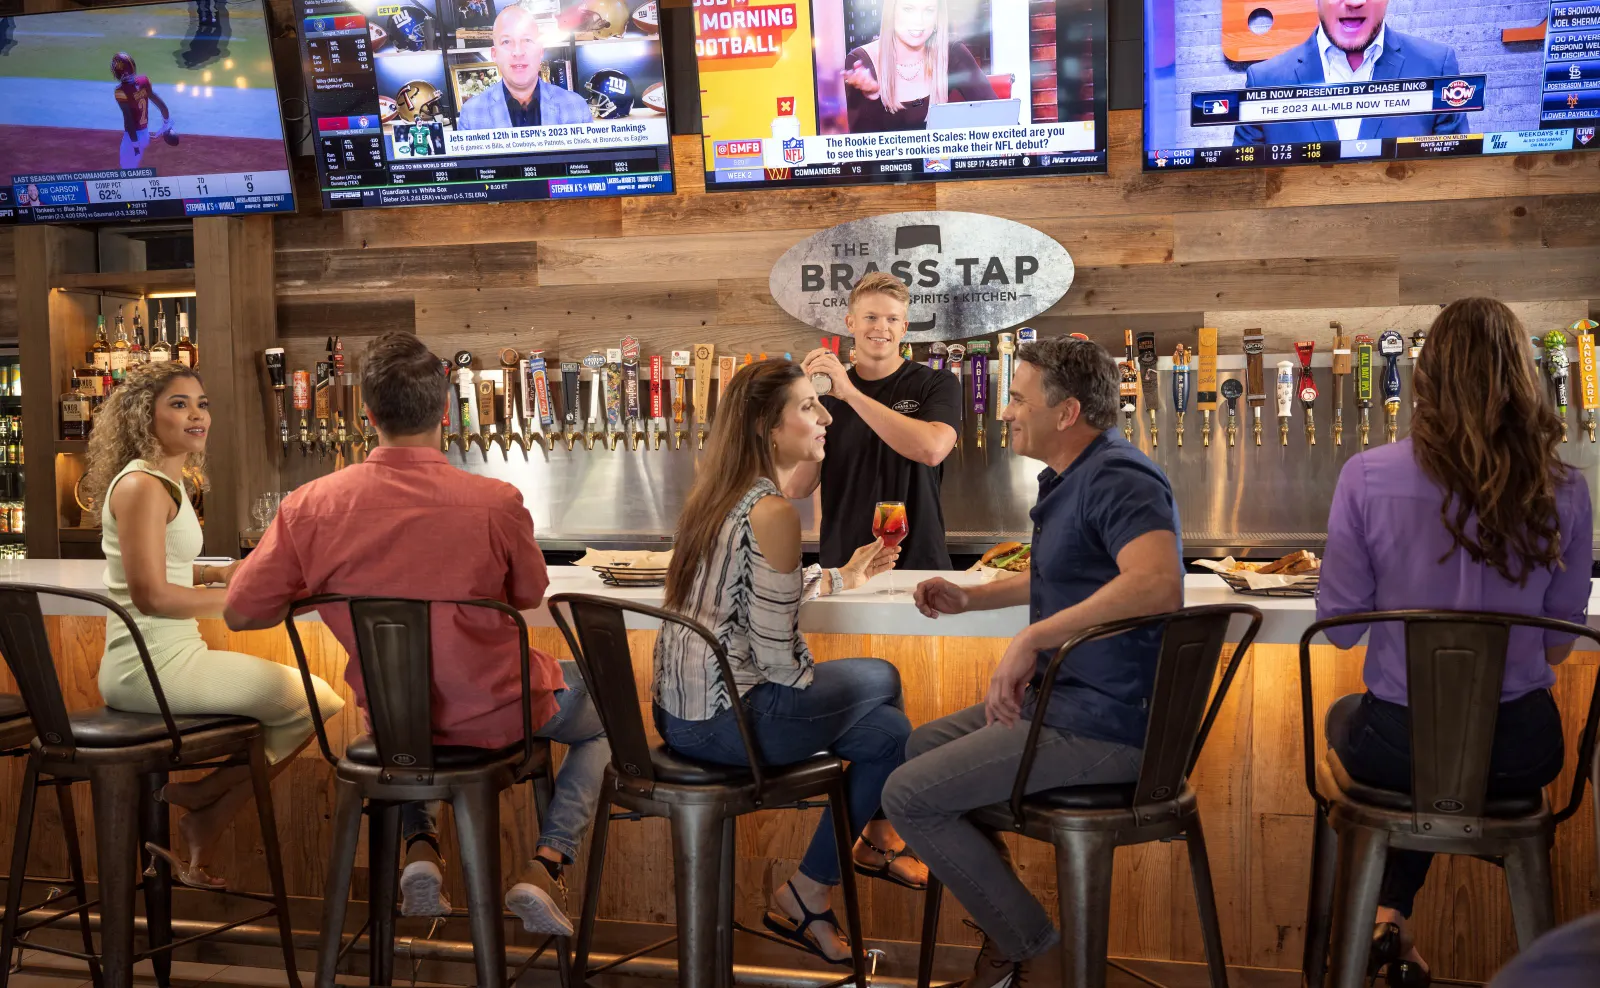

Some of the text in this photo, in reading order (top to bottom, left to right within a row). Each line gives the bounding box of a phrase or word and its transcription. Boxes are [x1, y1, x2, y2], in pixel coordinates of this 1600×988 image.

[1554, 6, 1600, 16] THE SHOWDOW
[702, 8, 793, 30] MORNING
[1553, 17, 1600, 28] JOEL SHERMA
[695, 34, 780, 57] OOTBALL
[1562, 51, 1600, 59] DISCIPLINE
[1246, 91, 1267, 101] MLB
[1270, 90, 1293, 99] NOW
[1296, 86, 1350, 97] PRESENTED
[1353, 85, 1366, 94] BY
[1368, 83, 1400, 93] CHASE
[1548, 82, 1582, 90] POSTSEASON
[1442, 85, 1476, 101] NOW
[1262, 99, 1410, 114] THE 2023 ALL-MLB NOW TEAM
[1568, 110, 1598, 118] PAYROLL?
[449, 124, 646, 143] Jets ranked 12th in ESPN's 2023 NFL Power Rankings
[826, 128, 1065, 147] The Rookie Excitement Scales: How excited are you
[730, 142, 759, 154] GMFB
[826, 150, 835, 159] to
[856, 148, 873, 157] this
[875, 146, 904, 159] year's
[906, 145, 940, 155] rookies
[943, 143, 968, 153] make
[971, 142, 992, 152] their
[995, 140, 1013, 150] NFL
[1016, 138, 1049, 149] debut?
[1493, 141, 1508, 149] BASE
[785, 149, 803, 162] NFL
[1052, 155, 1098, 163] NETWORK
[794, 167, 841, 176] COMMANDERS
[880, 163, 912, 172] BRONCOS
[967, 160, 978, 168] SEP
[14, 176, 29, 184] LAST
[30, 174, 56, 183] SEASON
[56, 173, 73, 181] WITH
[74, 171, 119, 180] COMMANDERS
[128, 169, 152, 177] GAMES)
[49, 185, 79, 194] CARSON
[141, 186, 171, 199] 1,755
[196, 185, 209, 195] 11
[246, 182, 254, 193] 9
[552, 183, 574, 193] STEPHEN
[588, 182, 606, 191] WORLD
[51, 194, 76, 202] WENTZ
[99, 189, 121, 200] 62%
[186, 203, 206, 212] STEPHEN
[832, 242, 869, 257] THE
[955, 255, 1039, 286] TAP
[823, 298, 849, 308] CRA
[962, 292, 1017, 302] KITCHEN
[1582, 336, 1593, 371] MANGO
[1361, 353, 1369, 391] ALL DAY IPA
[1586, 375, 1594, 403] CART
[64, 404, 78, 412] KNOB
